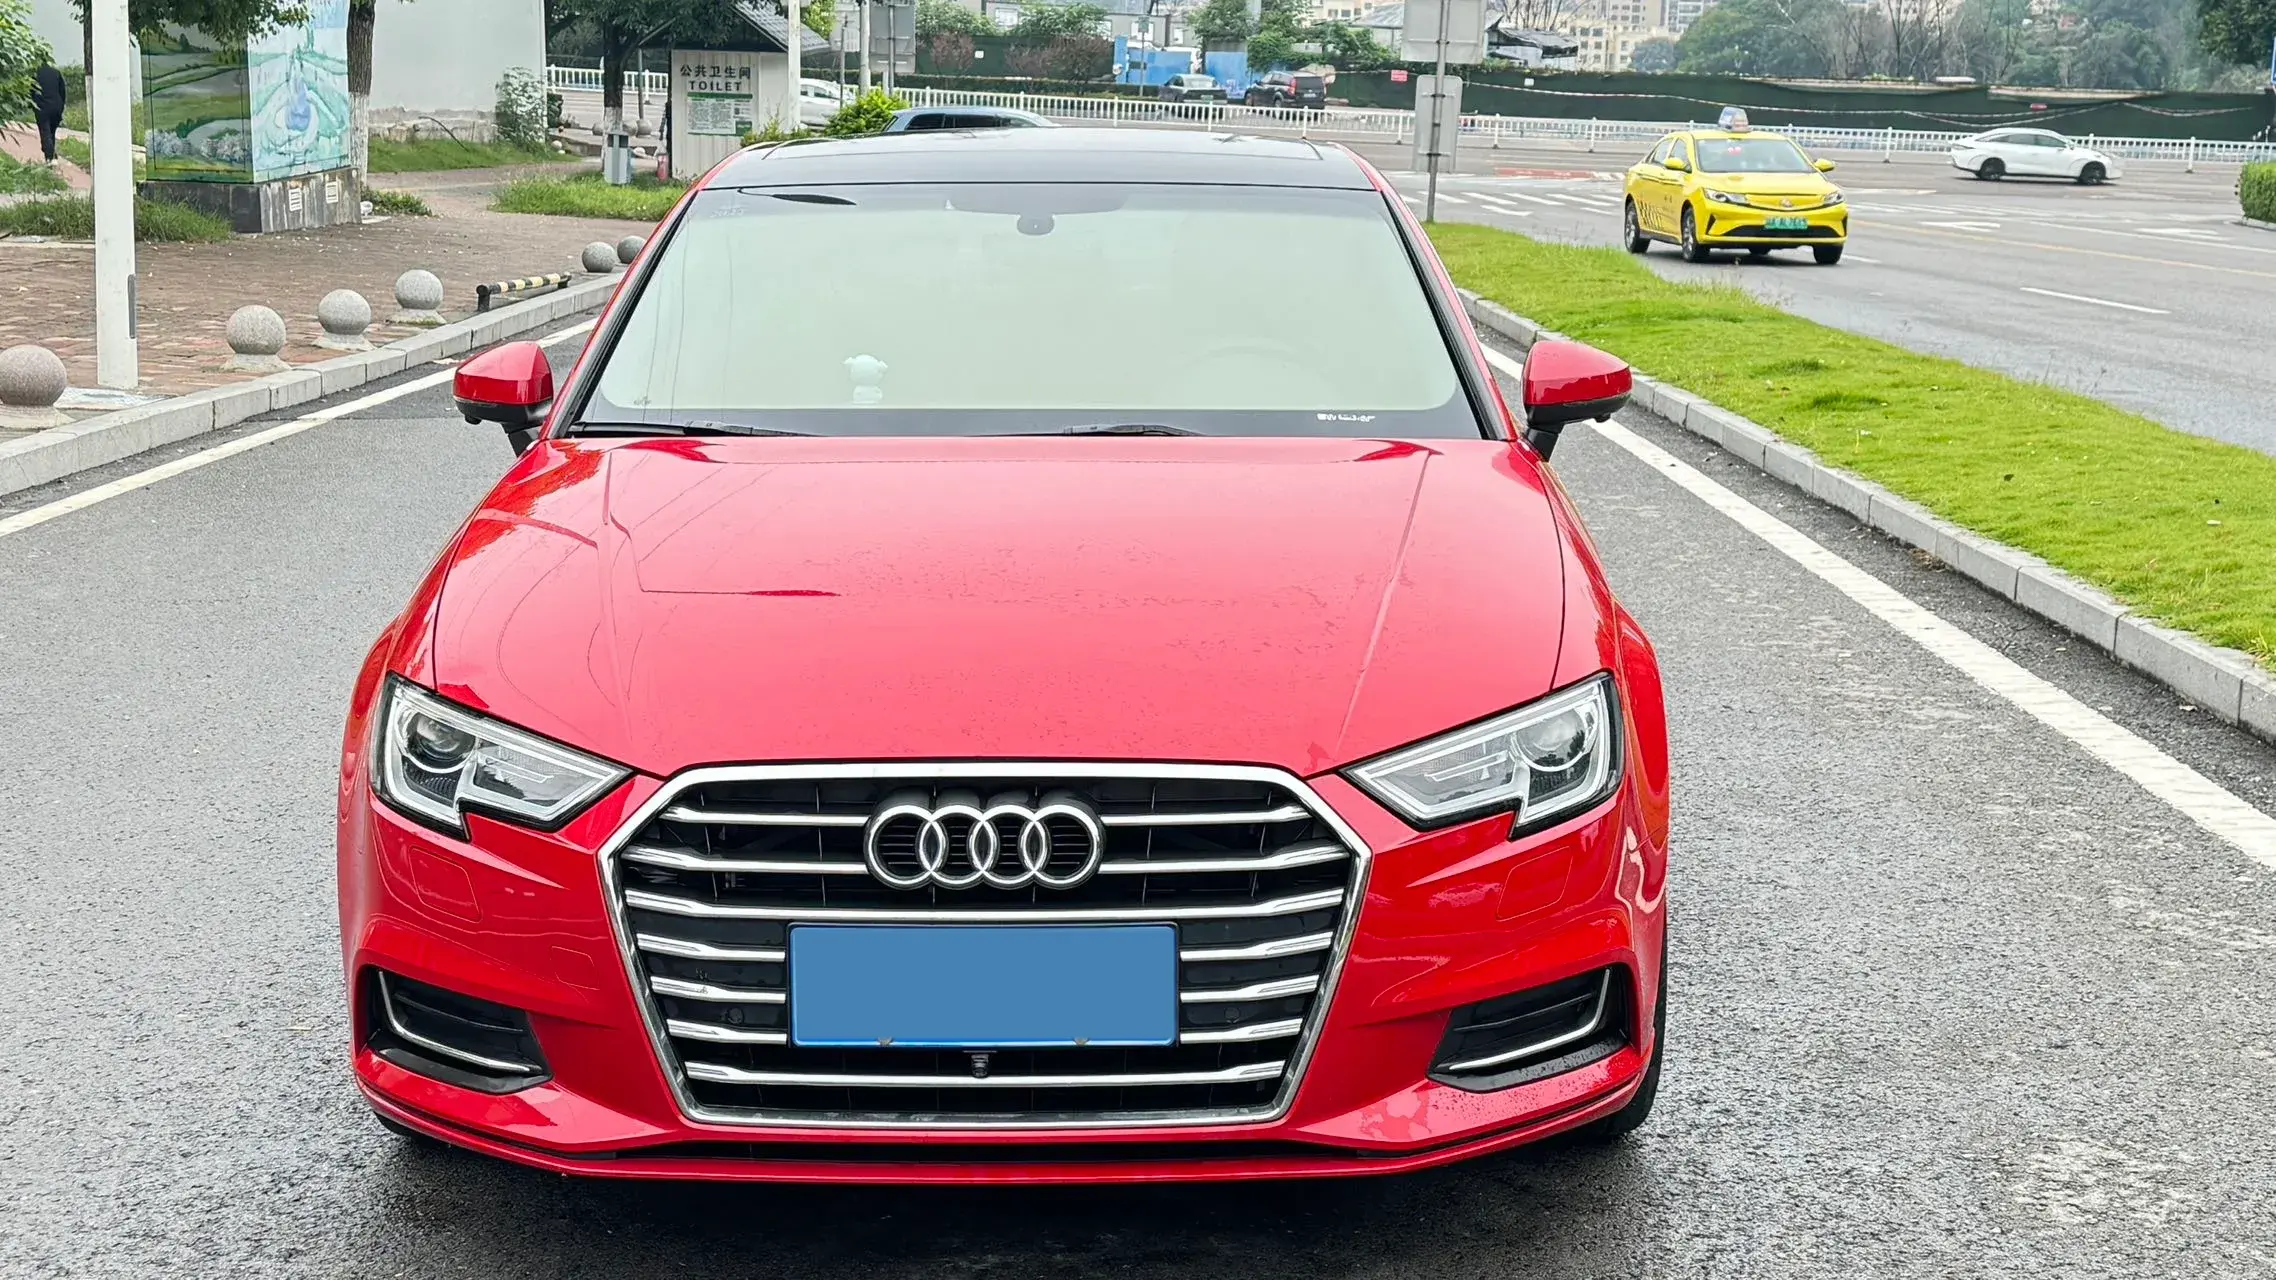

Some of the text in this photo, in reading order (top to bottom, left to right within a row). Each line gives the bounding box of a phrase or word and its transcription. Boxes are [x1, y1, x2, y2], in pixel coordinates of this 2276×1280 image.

[680, 64, 751, 80] 公共卫生间
[689, 80, 742, 91] TOILET
